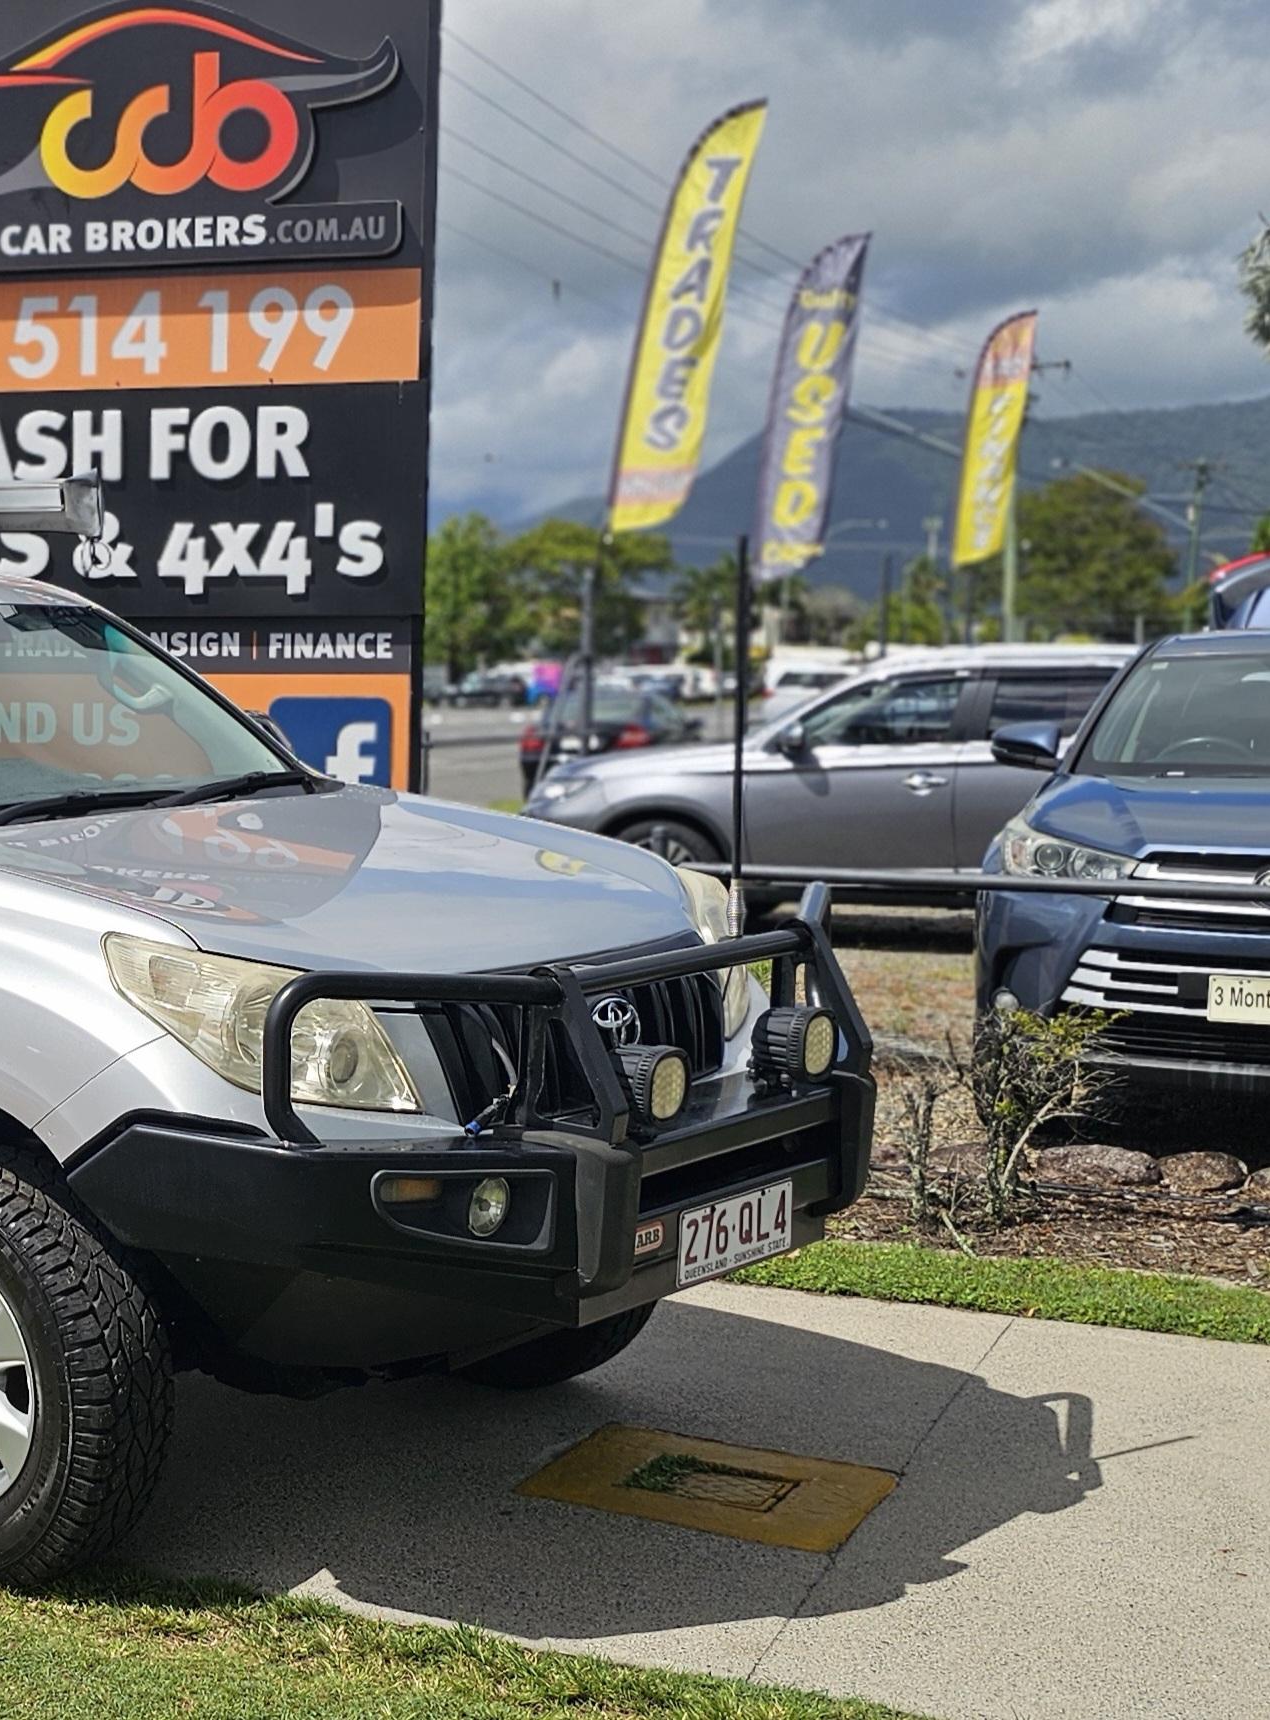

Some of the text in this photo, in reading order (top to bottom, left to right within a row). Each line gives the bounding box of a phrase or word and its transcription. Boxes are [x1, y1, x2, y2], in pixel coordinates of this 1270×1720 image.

[0, 223, 72, 255] CAR
[645, 157, 741, 451] TRADES
[7, 291, 167, 378] 514
[198, 285, 354, 372] 199
[150, 406, 310, 479] FOR
[772, 321, 846, 529] USED
[72, 511, 138, 578] &
[268, 632, 393, 659] FINANCE
[72, 701, 141, 746] US
[1214, 986, 1224, 1006] 3
[636, 1228, 660, 1249] ARB
[684, 1237, 787, 1280] QUEENSLAND SUNSHINE STATE
